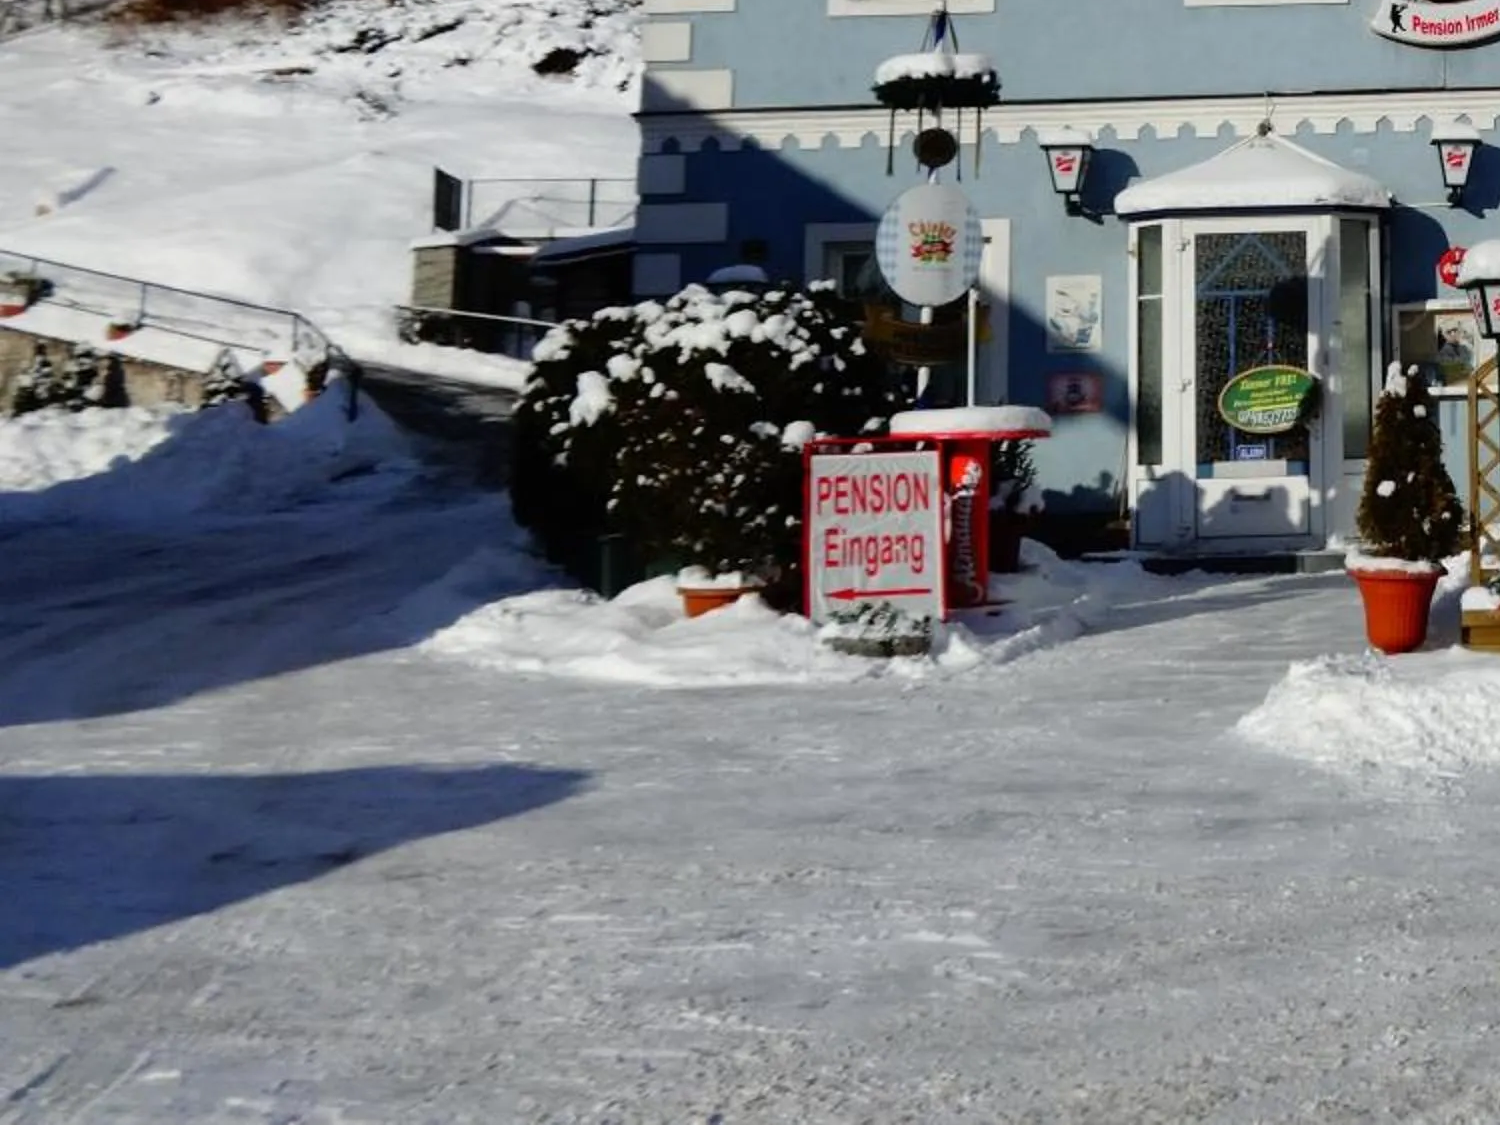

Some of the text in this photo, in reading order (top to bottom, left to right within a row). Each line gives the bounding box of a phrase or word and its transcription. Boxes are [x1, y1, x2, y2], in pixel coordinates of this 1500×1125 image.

[1412, 7, 1500, 36] Pension Irmer
[816, 473, 930, 516] PENSION
[823, 527, 925, 577] Eingang
